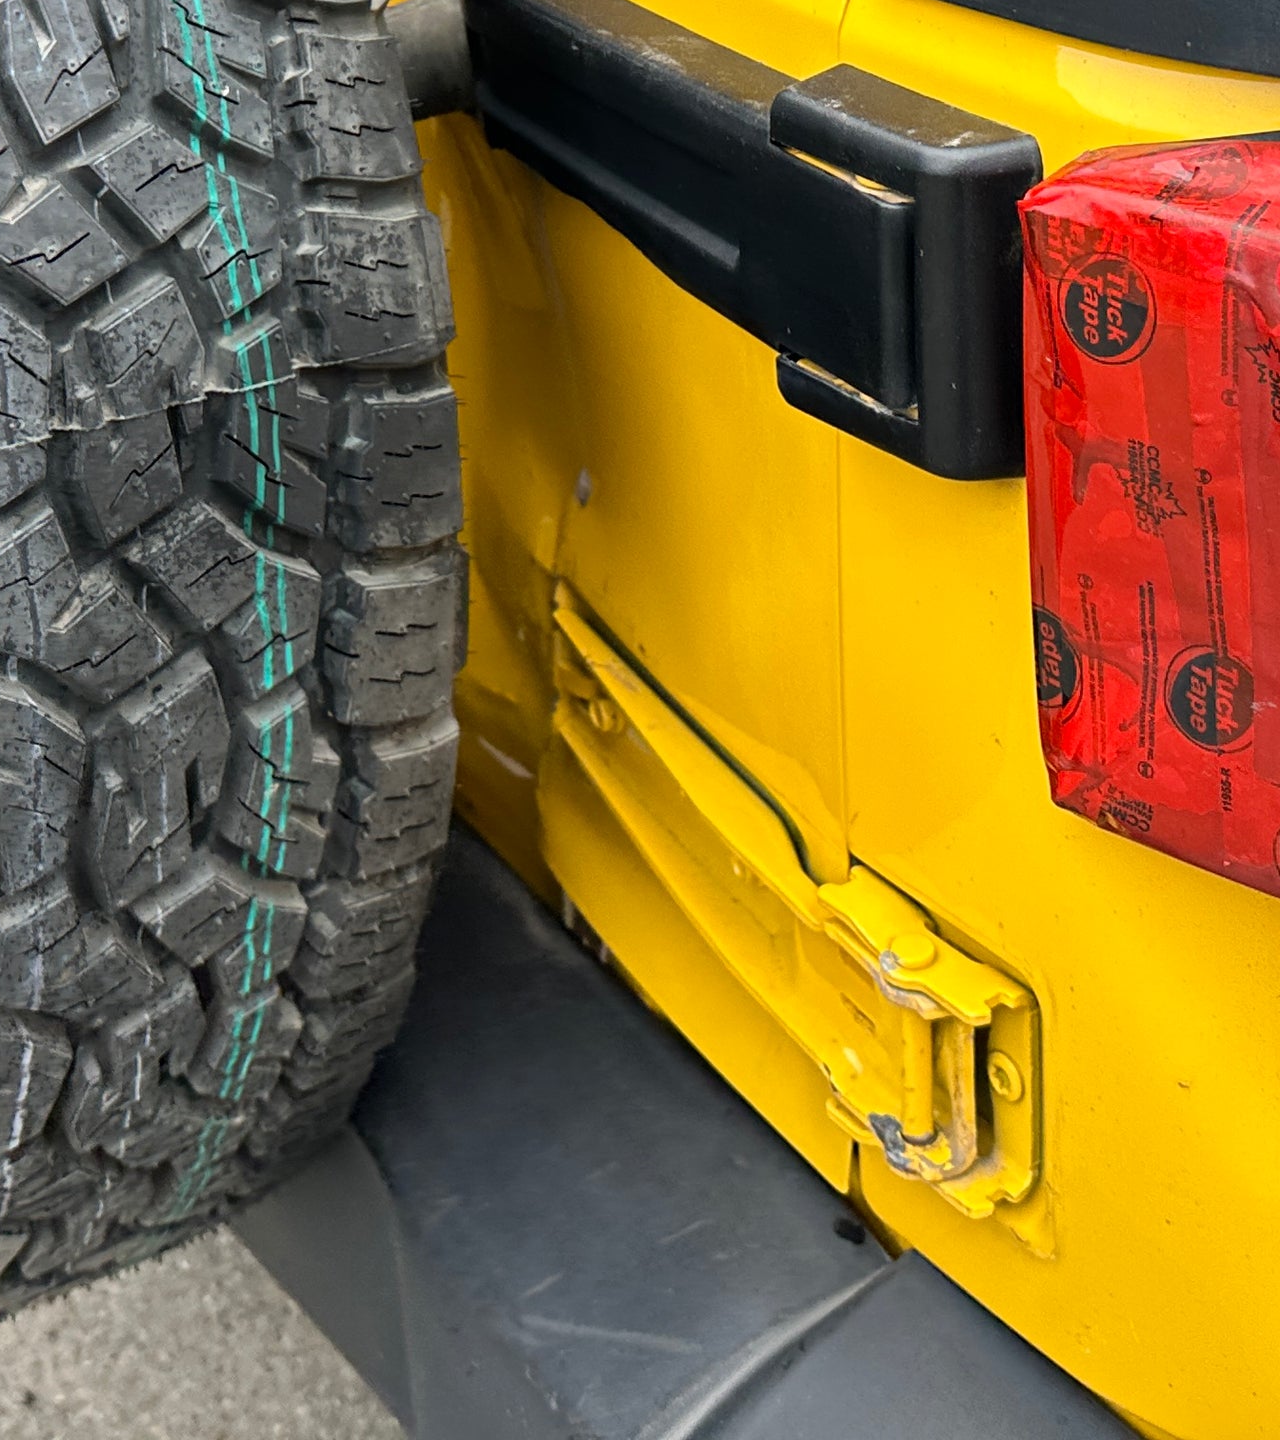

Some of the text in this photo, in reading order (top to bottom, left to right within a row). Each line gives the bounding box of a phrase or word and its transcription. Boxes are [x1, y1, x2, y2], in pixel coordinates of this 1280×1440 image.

[1077, 272, 1101, 346] Tape
[1106, 271, 1129, 346] Tuck
[1040, 620, 1063, 687] Tape
[1188, 665, 1211, 734] Tape
[1216, 666, 1238, 734] Tuck
[1221, 767, 1233, 812] 11955-R
